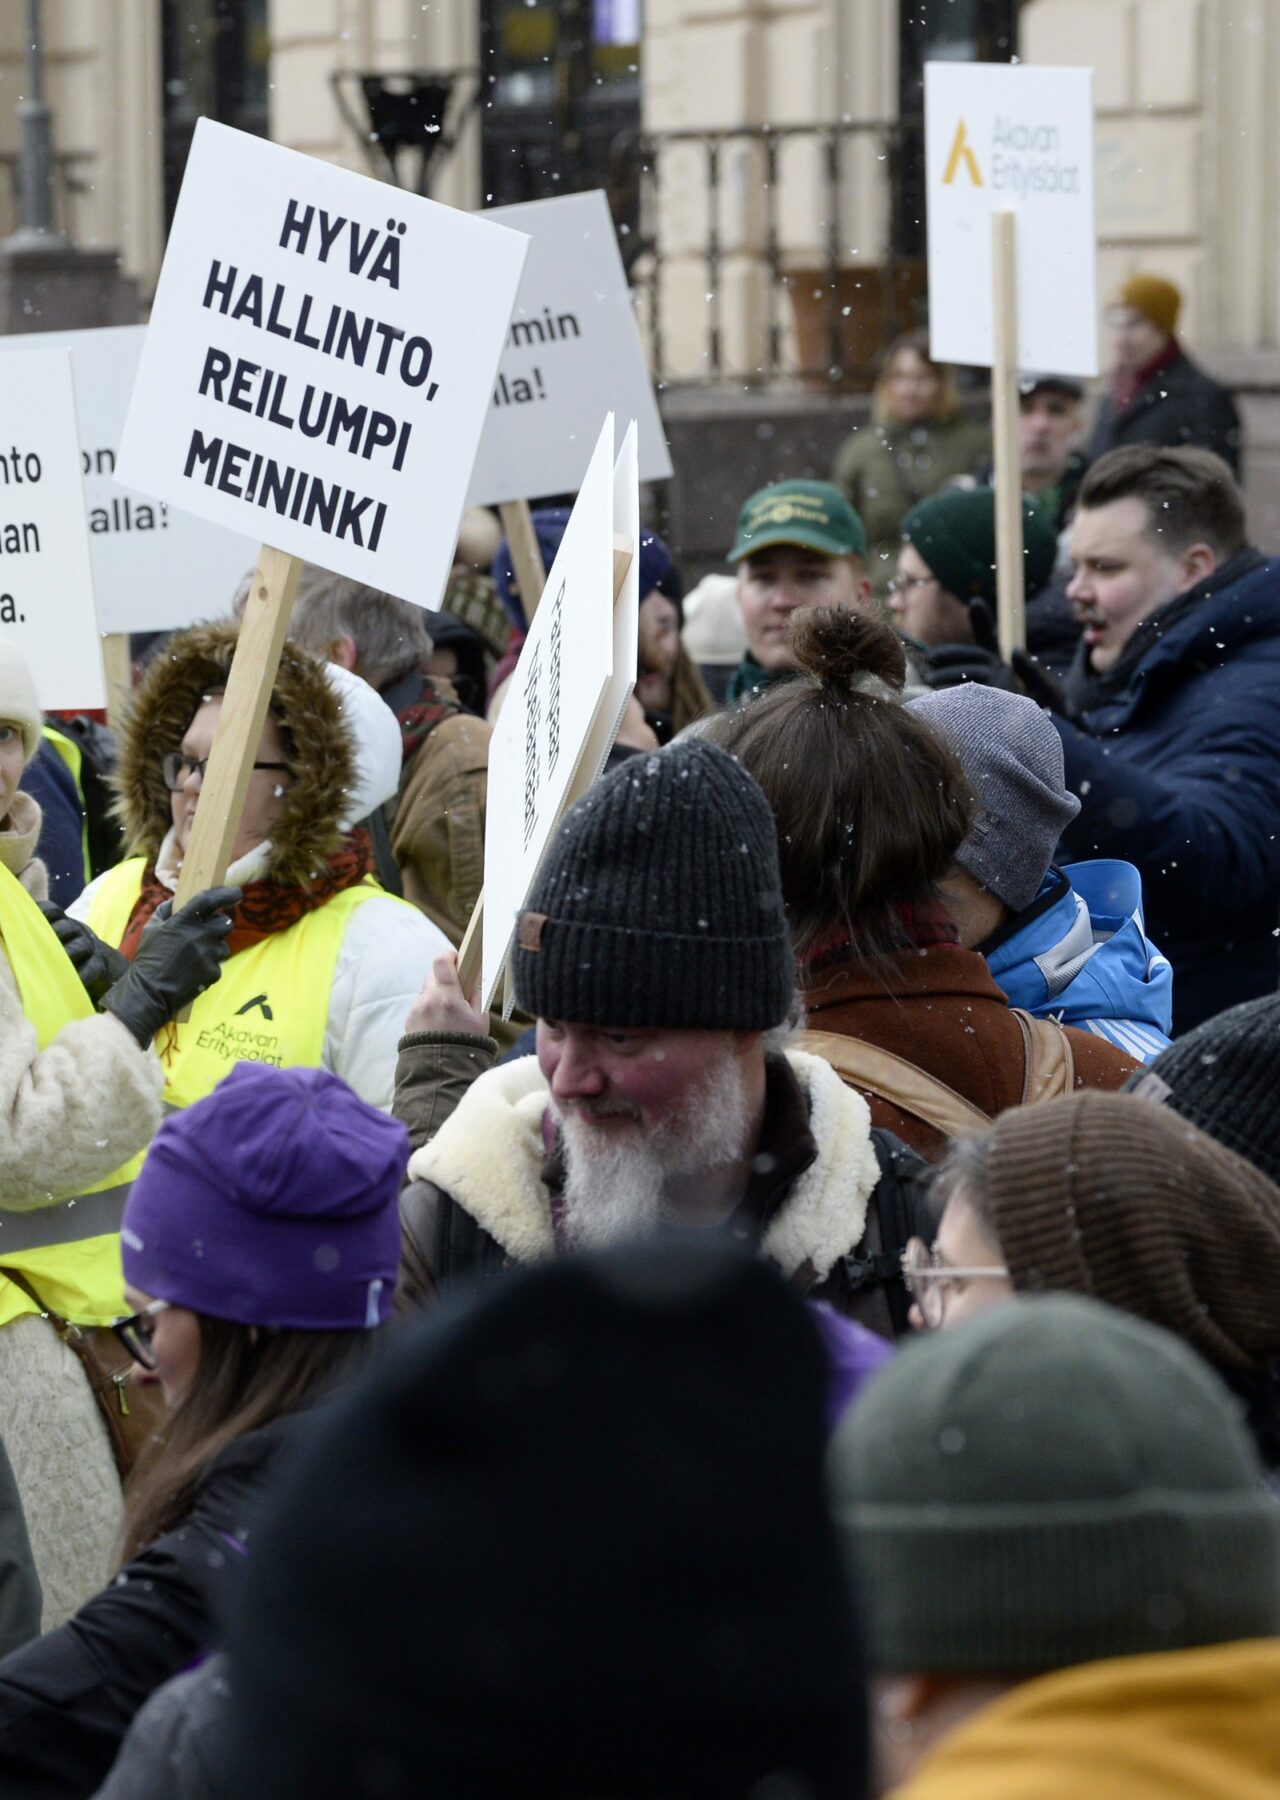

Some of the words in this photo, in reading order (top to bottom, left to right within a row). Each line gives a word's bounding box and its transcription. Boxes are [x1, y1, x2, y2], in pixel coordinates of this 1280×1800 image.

[279, 198, 407, 290] HYVÄ
[202, 260, 439, 401] HALLINTO,
[506, 307, 580, 348] min
[198, 347, 412, 472] REILUMPI
[183, 429, 387, 552] MEININKI
[196, 1030, 284, 1068] Erityisalat
[213, 1022, 278, 1050] Akavan
